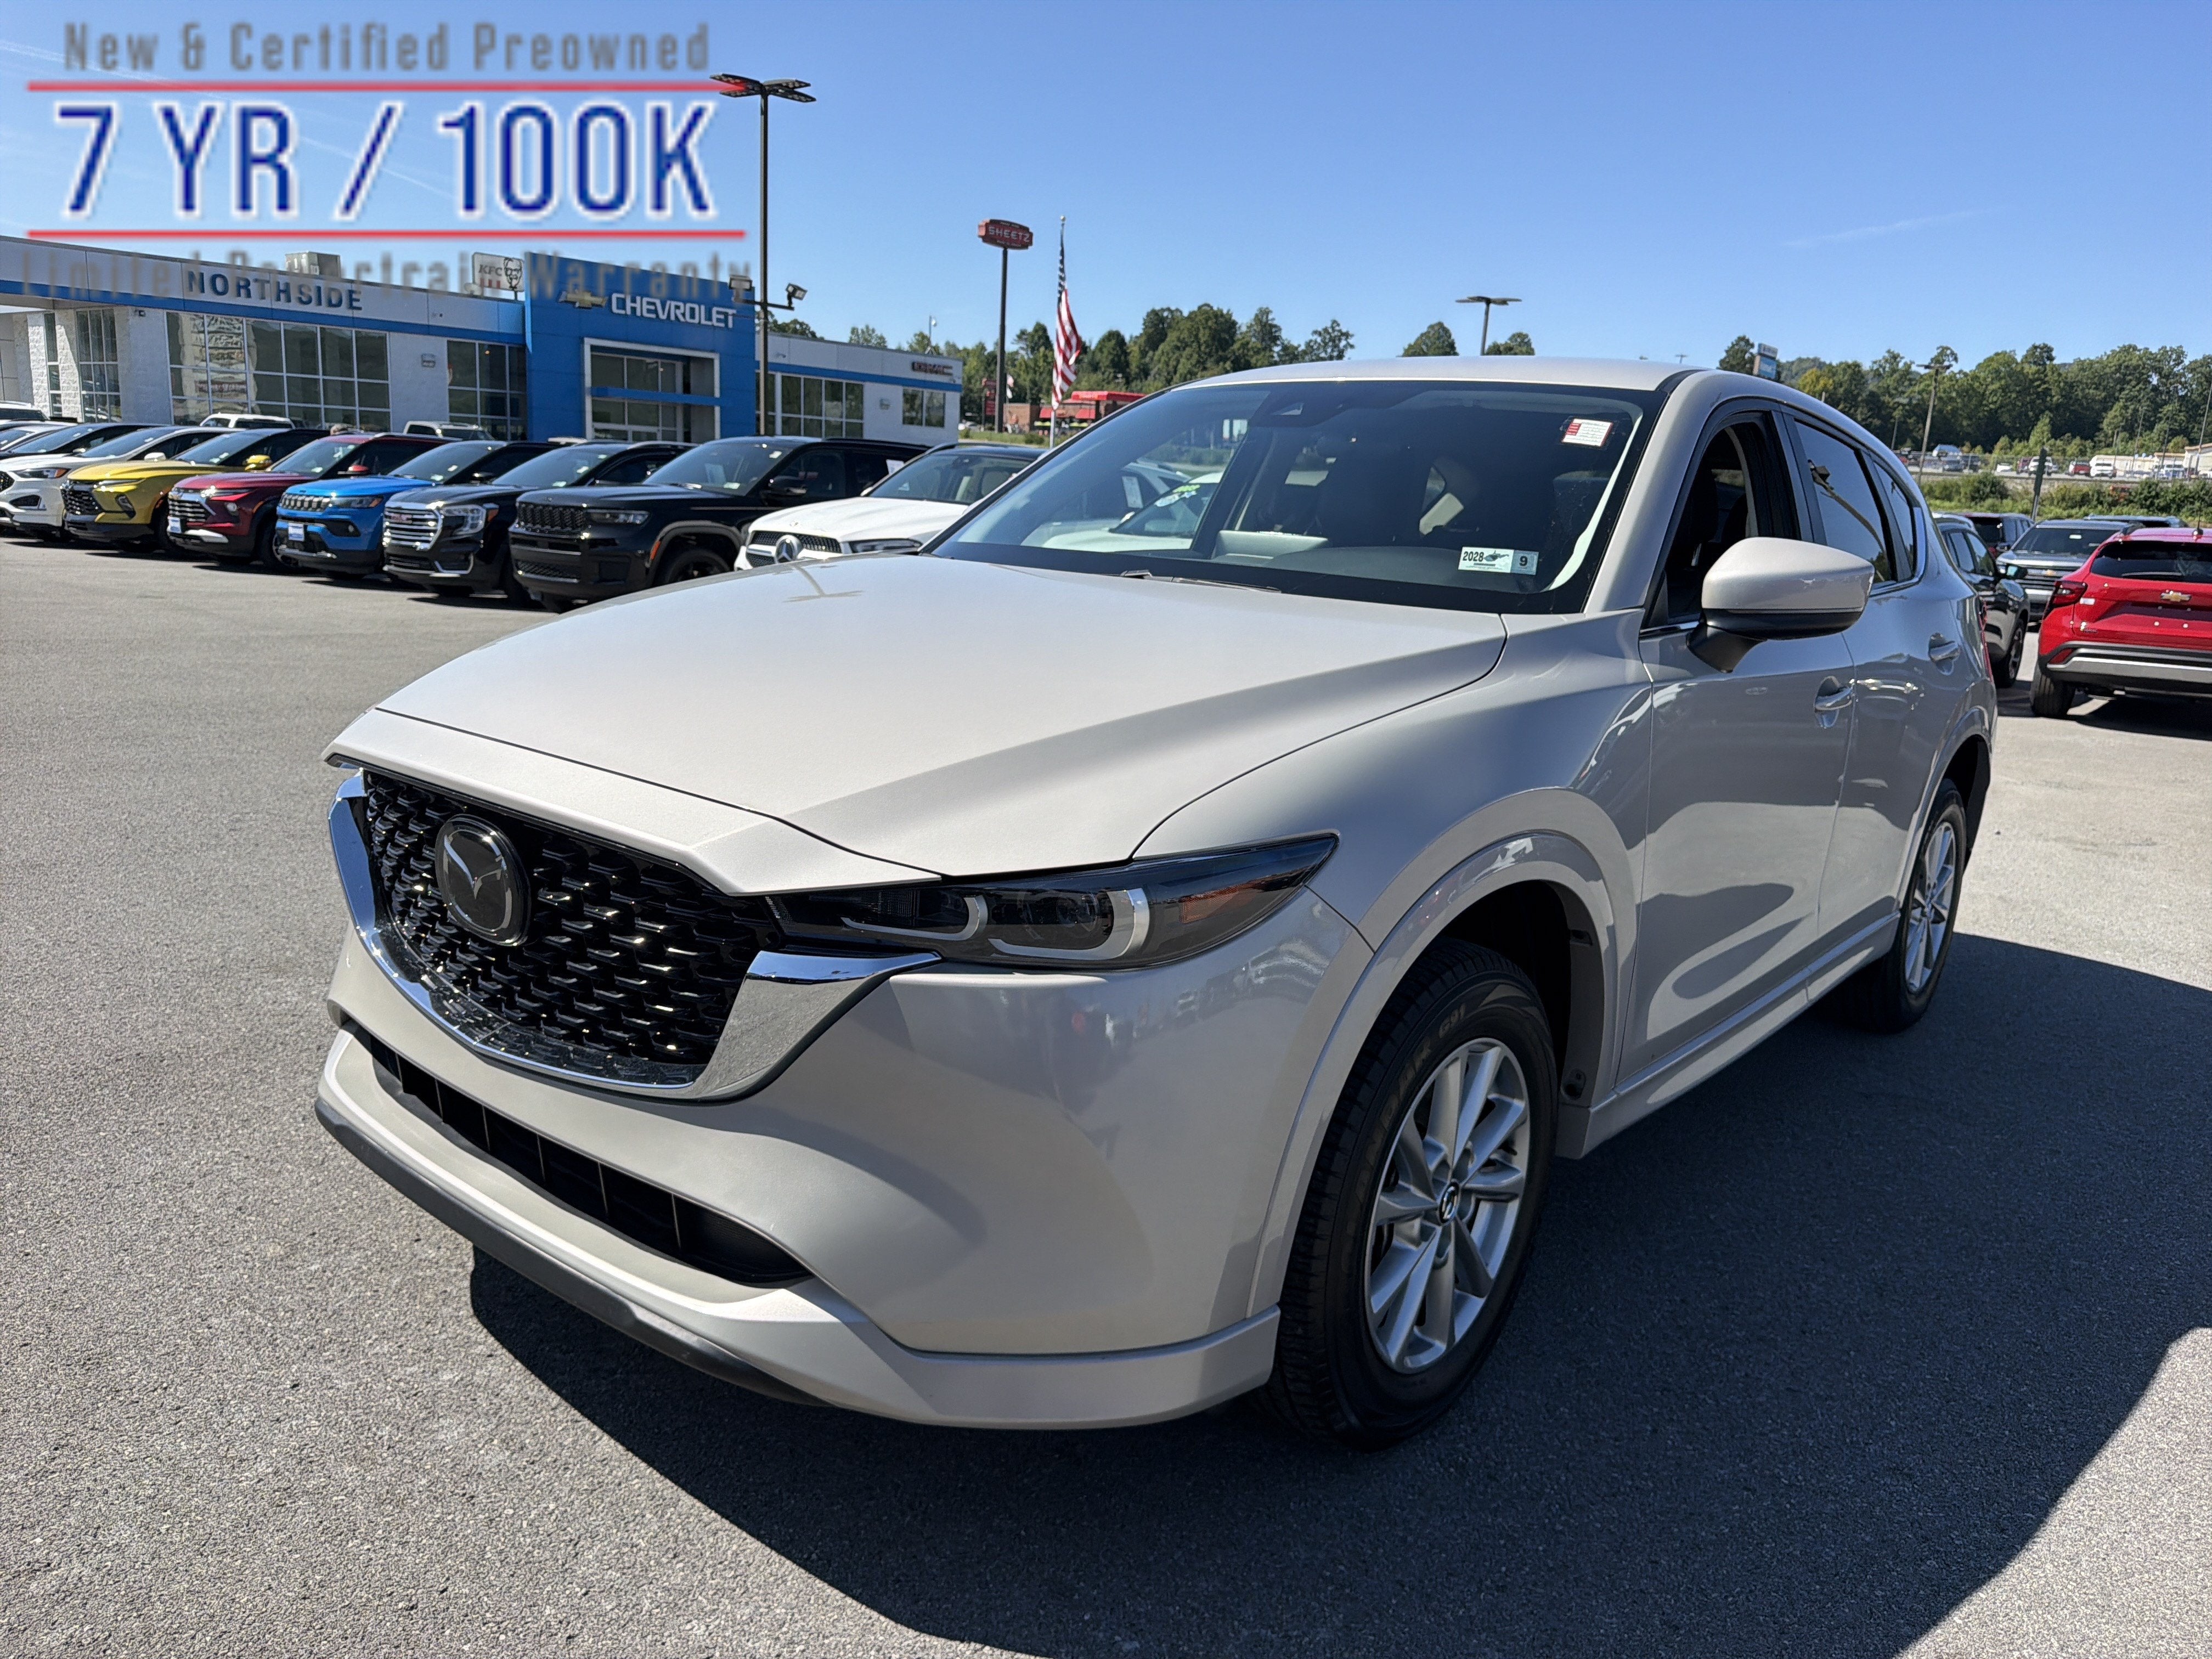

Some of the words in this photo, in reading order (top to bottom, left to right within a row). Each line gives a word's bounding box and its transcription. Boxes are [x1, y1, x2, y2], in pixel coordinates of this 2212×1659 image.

[989, 226, 1030, 242] SHEETZ
[479, 264, 502, 276] KFC
[188, 270, 363, 311] NORTHSIDE
[611, 292, 736, 328] CHEVROLET
[1463, 551, 1484, 562] 2028
[1519, 556, 1528, 566] 9
